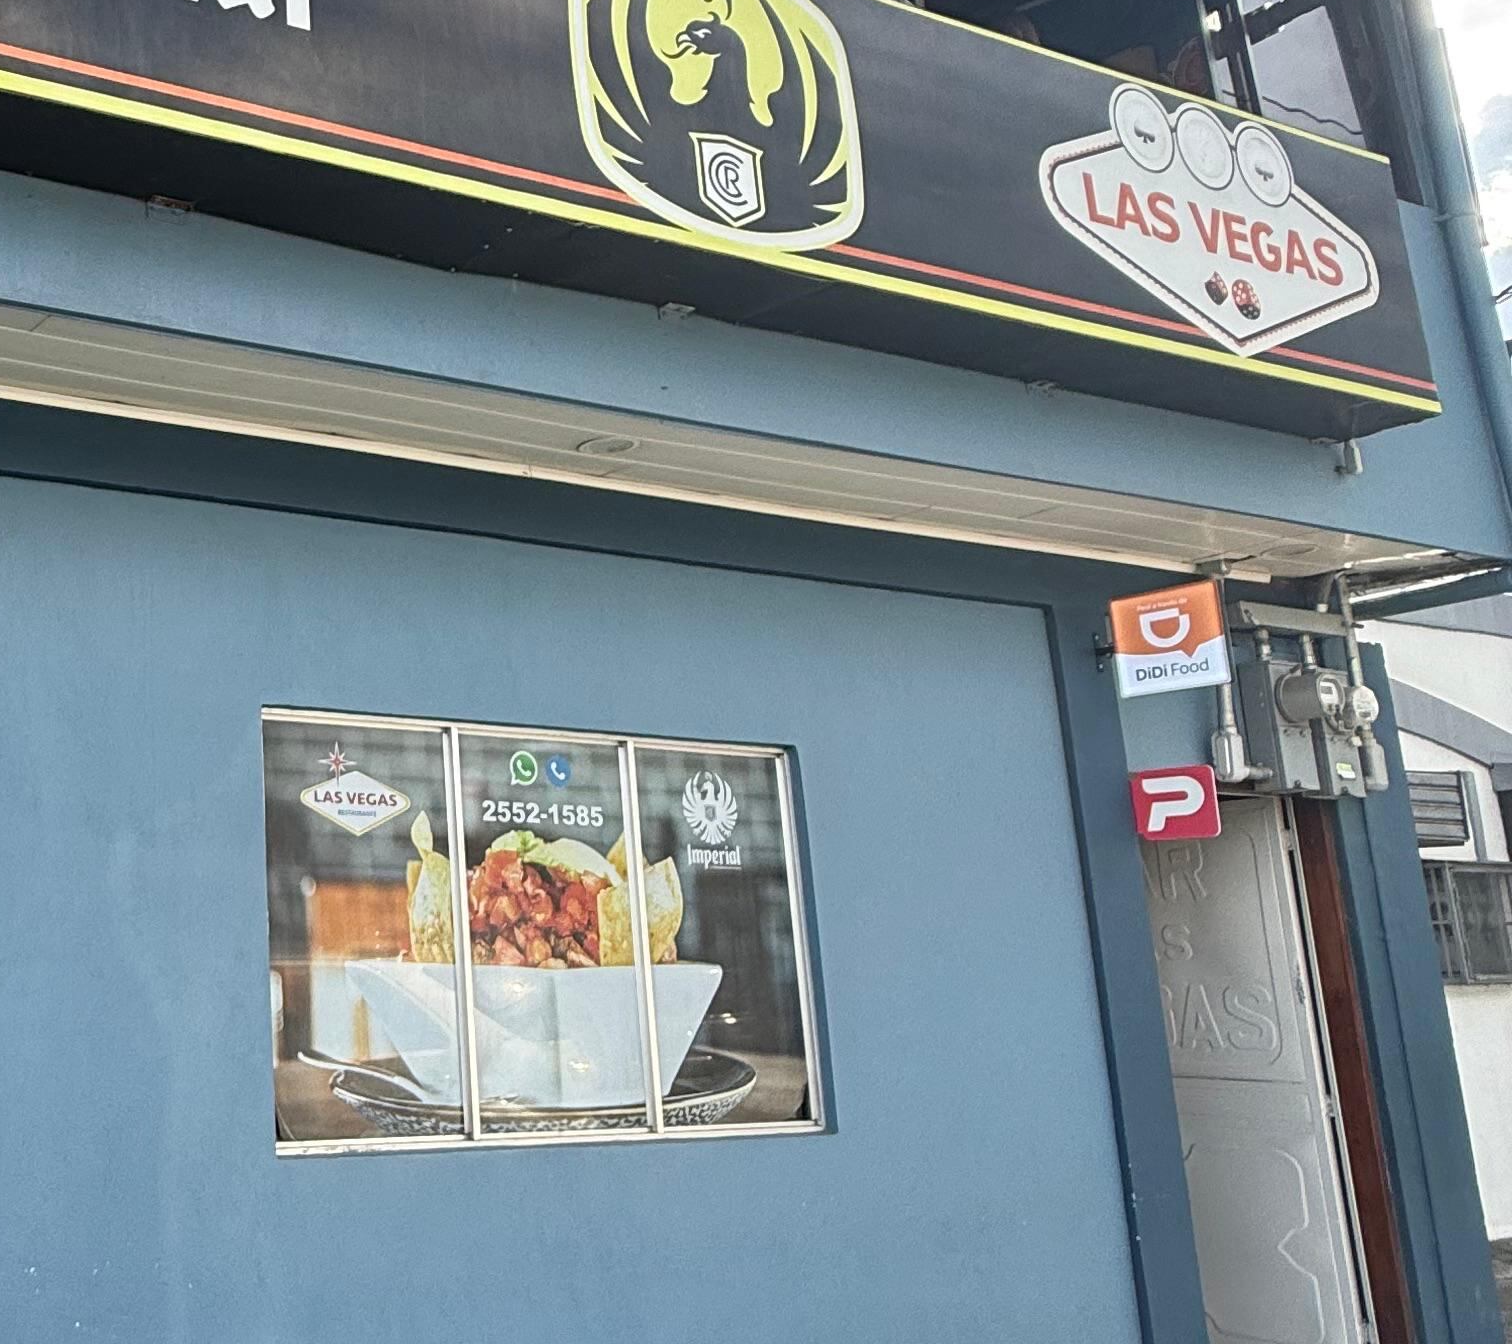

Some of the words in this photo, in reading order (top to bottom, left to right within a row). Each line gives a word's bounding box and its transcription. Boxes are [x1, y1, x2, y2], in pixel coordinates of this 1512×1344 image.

[1081, 171, 1181, 244] LAS
[1187, 200, 1344, 287] VEGAS
[1135, 663, 1168, 682] DiDi
[1170, 657, 1210, 676] Food
[314, 790, 343, 804] LAS
[346, 791, 398, 807] VEGAS
[482, 799, 604, 827] 2552-1585
[686, 843, 742, 870] Imperial
